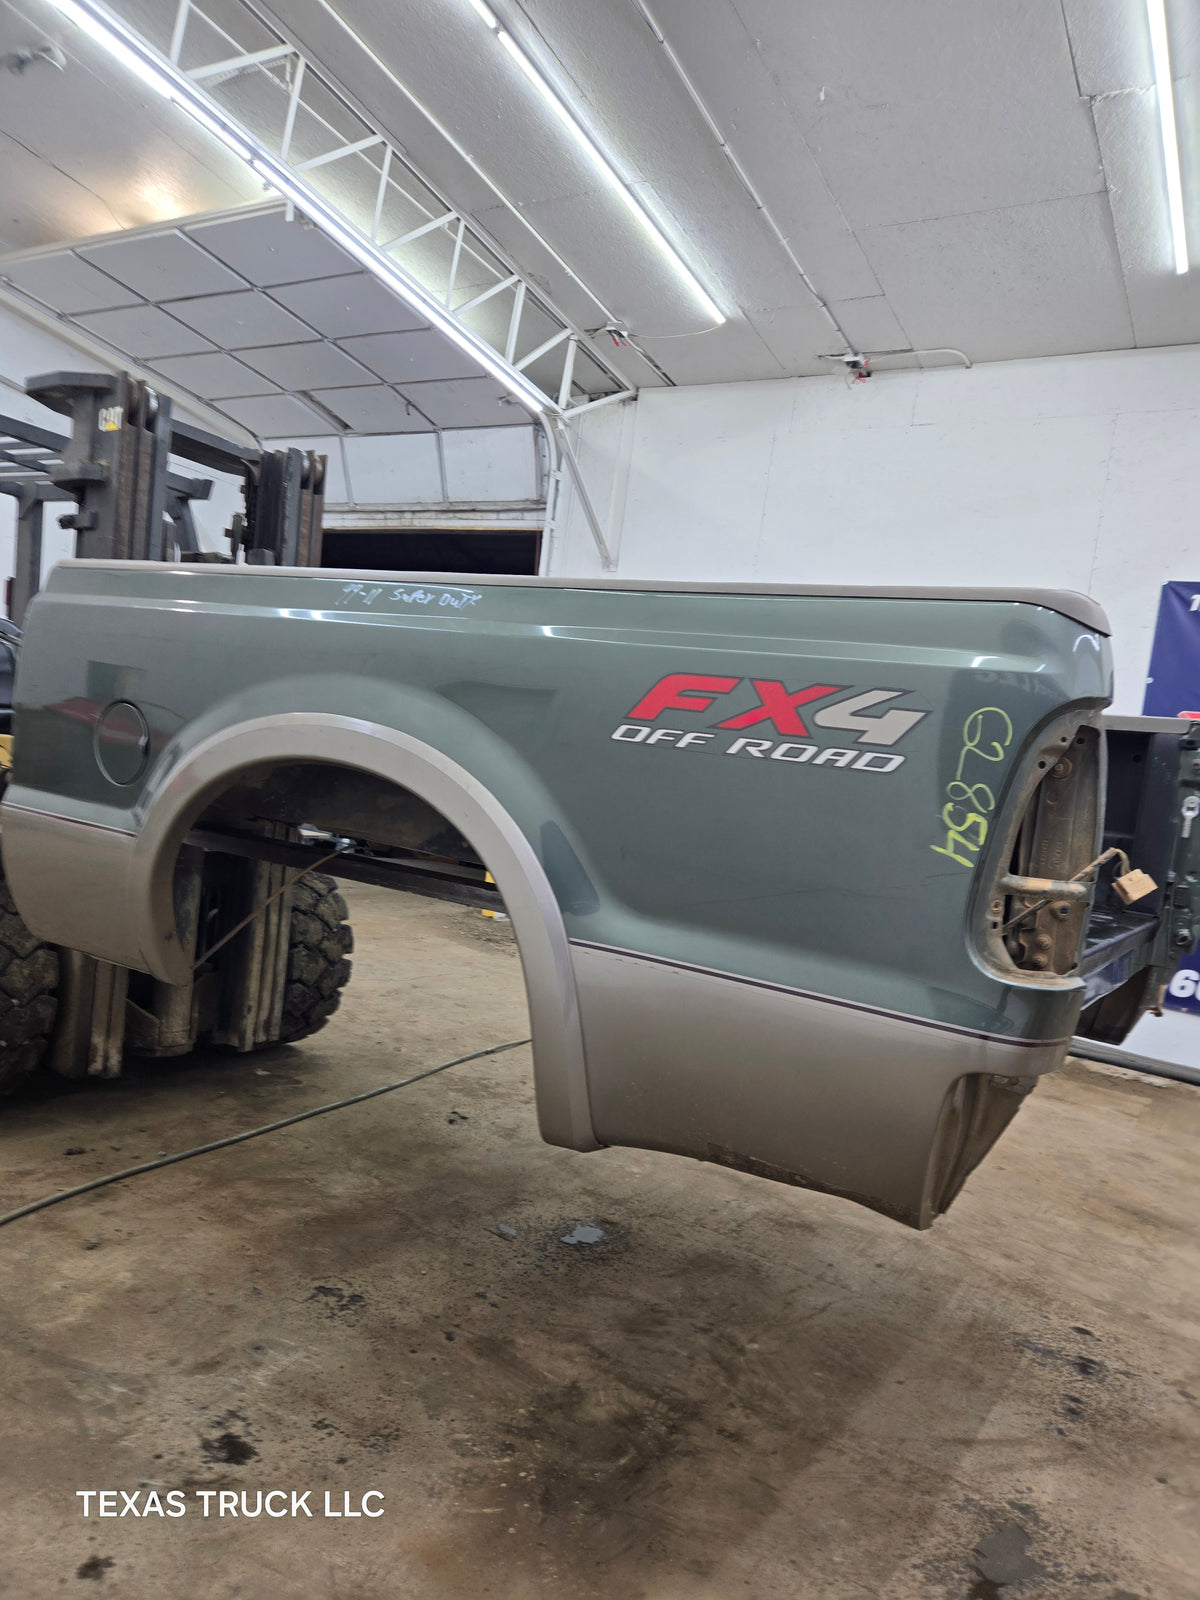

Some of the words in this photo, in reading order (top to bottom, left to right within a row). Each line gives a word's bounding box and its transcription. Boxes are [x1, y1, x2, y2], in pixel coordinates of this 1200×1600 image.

[623, 672, 933, 747] FX4
[611, 725, 714, 748] OFF
[726, 738, 905, 771] ROAD
